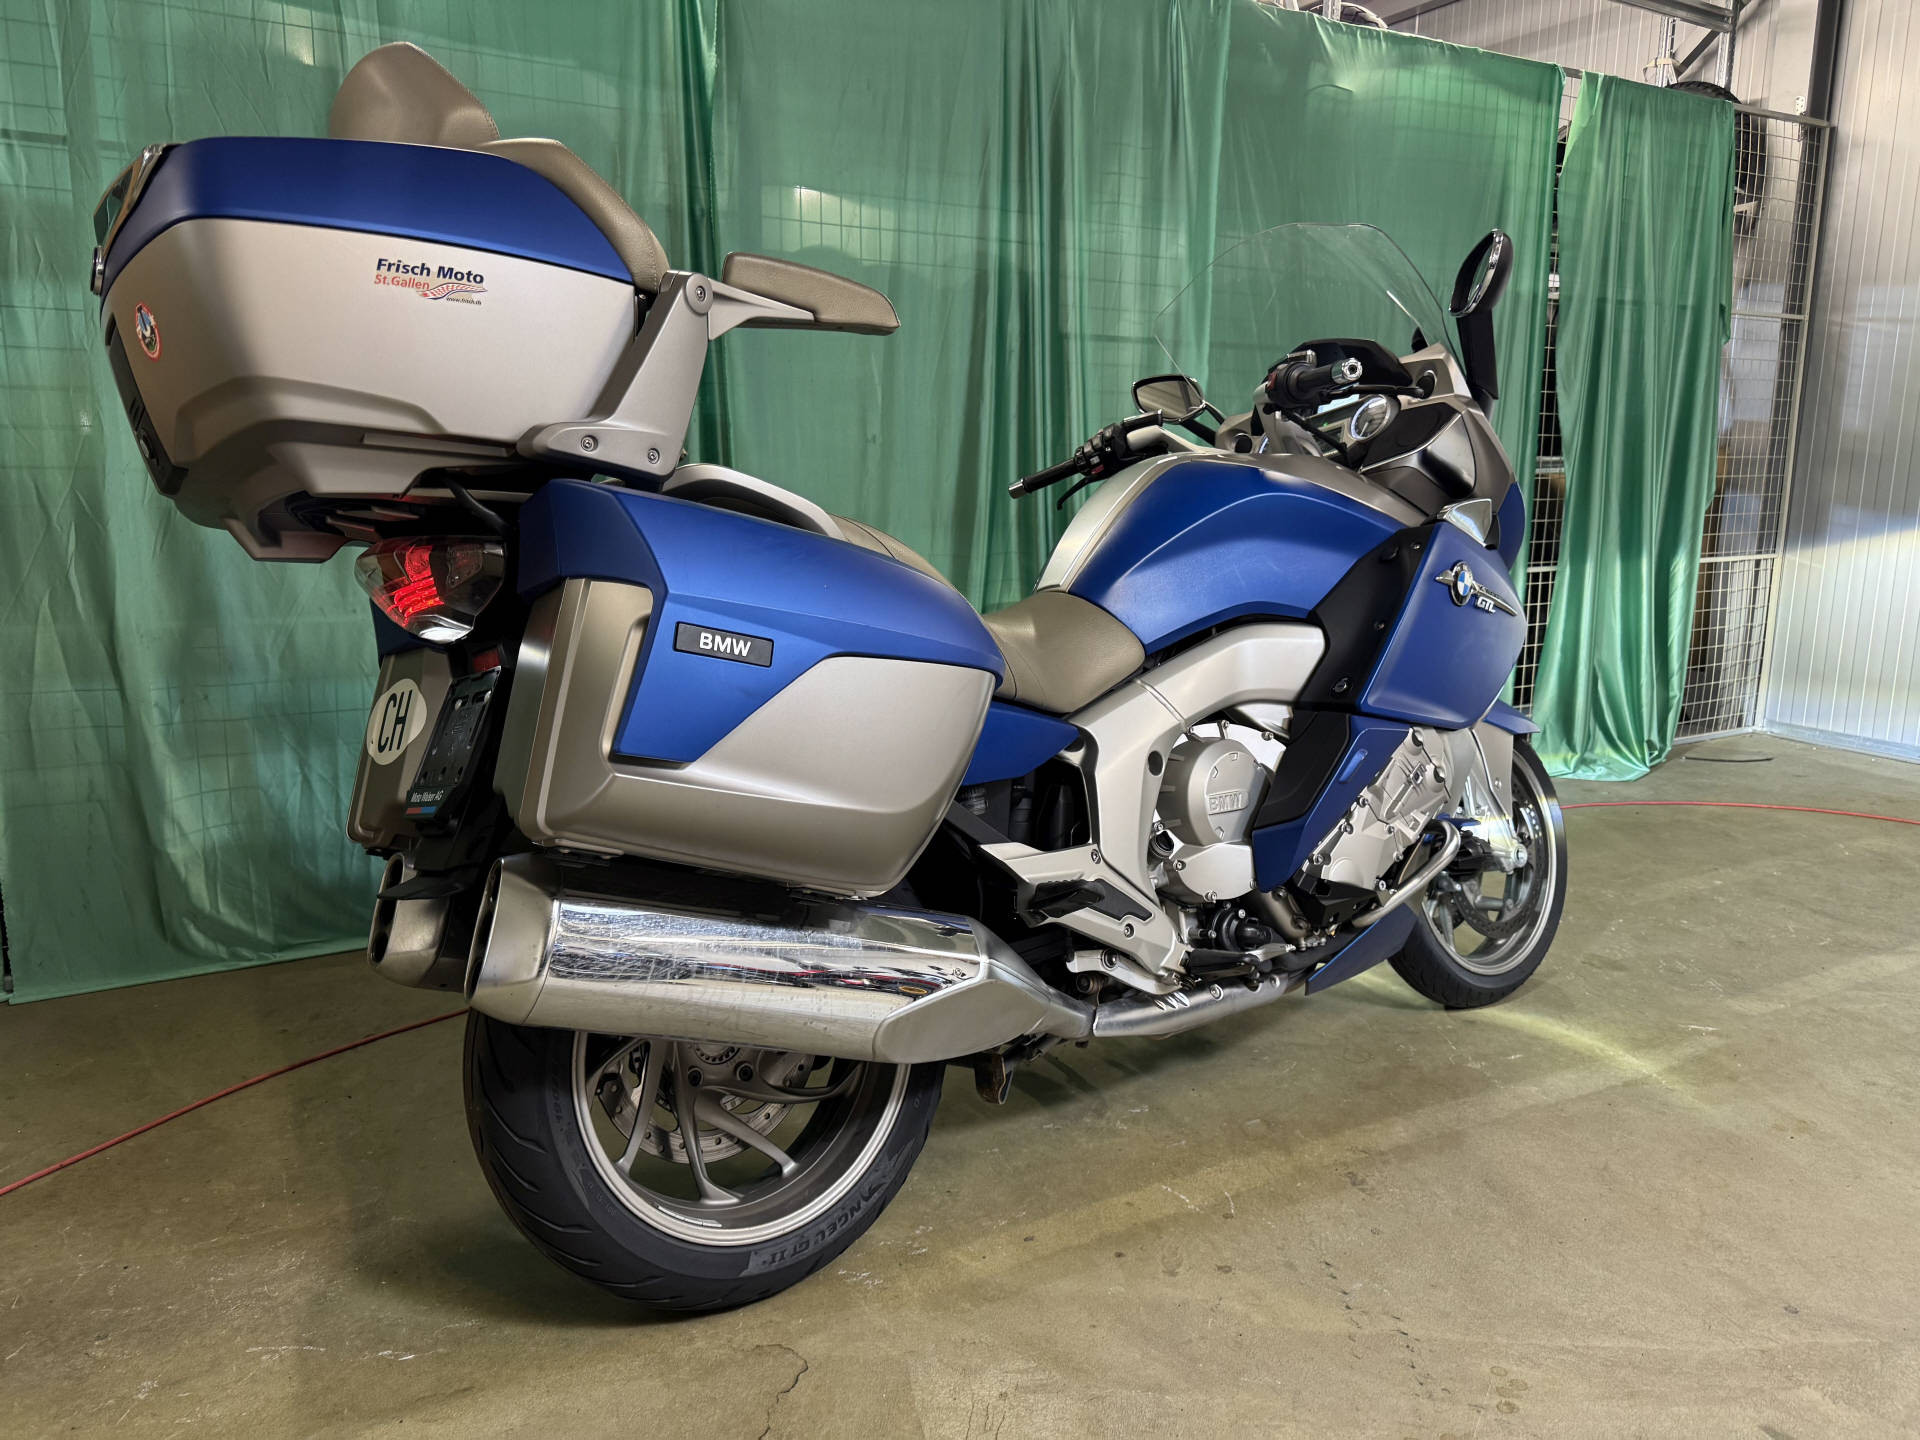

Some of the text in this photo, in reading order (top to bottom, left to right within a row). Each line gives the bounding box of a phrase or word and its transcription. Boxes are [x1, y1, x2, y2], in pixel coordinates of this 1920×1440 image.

[374, 273, 430, 290] St.Gallen
[376, 258, 485, 284] Frisch Moto
[1477, 596, 1496, 614] GTL
[699, 632, 752, 657] BMW
[377, 689, 413, 754] CH
[1208, 792, 1242, 811] BMW
[815, 1182, 890, 1240] ANGEL
[790, 1240, 810, 1256] GT
